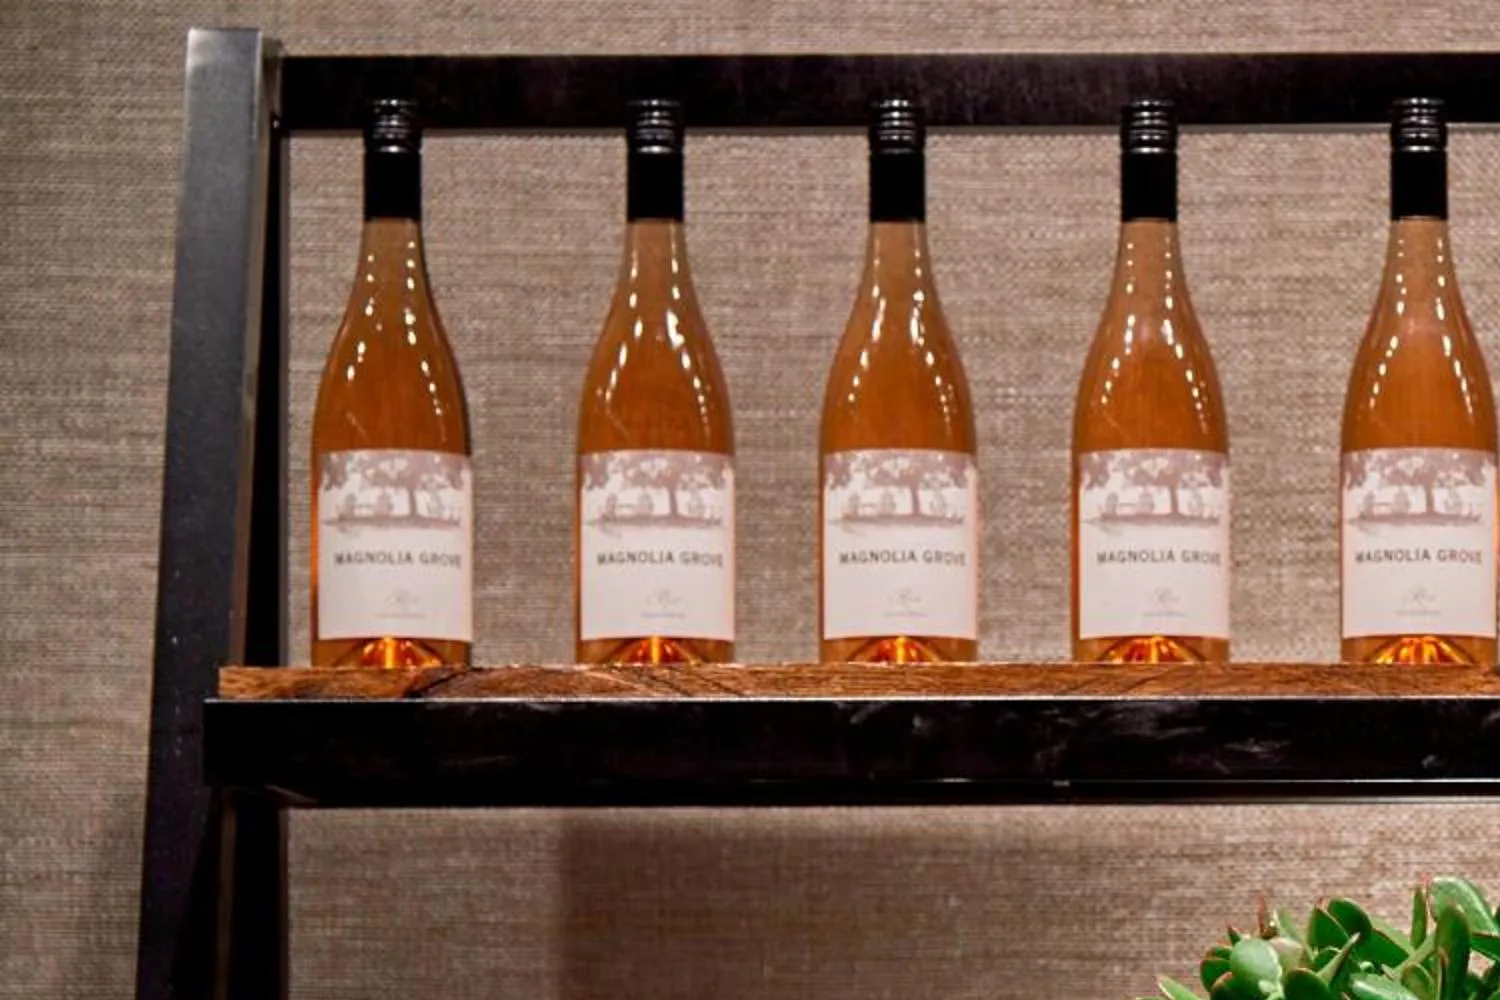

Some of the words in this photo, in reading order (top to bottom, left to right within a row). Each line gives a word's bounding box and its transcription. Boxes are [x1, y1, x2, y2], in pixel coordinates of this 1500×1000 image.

[333, 551, 413, 567] MAGNOLIA
[418, 552, 462, 569] GROVE
[596, 551, 675, 567] MAGNOLIA
[680, 551, 723, 569] GROVE
[838, 549, 918, 565] MAGNOLIA
[921, 549, 965, 567] GROVE
[1095, 549, 1176, 565] MAGNOLIA
[1180, 549, 1222, 567] GROVE
[1356, 548, 1432, 565] MAGNOLIA
[1435, 548, 1483, 565] GROVE
